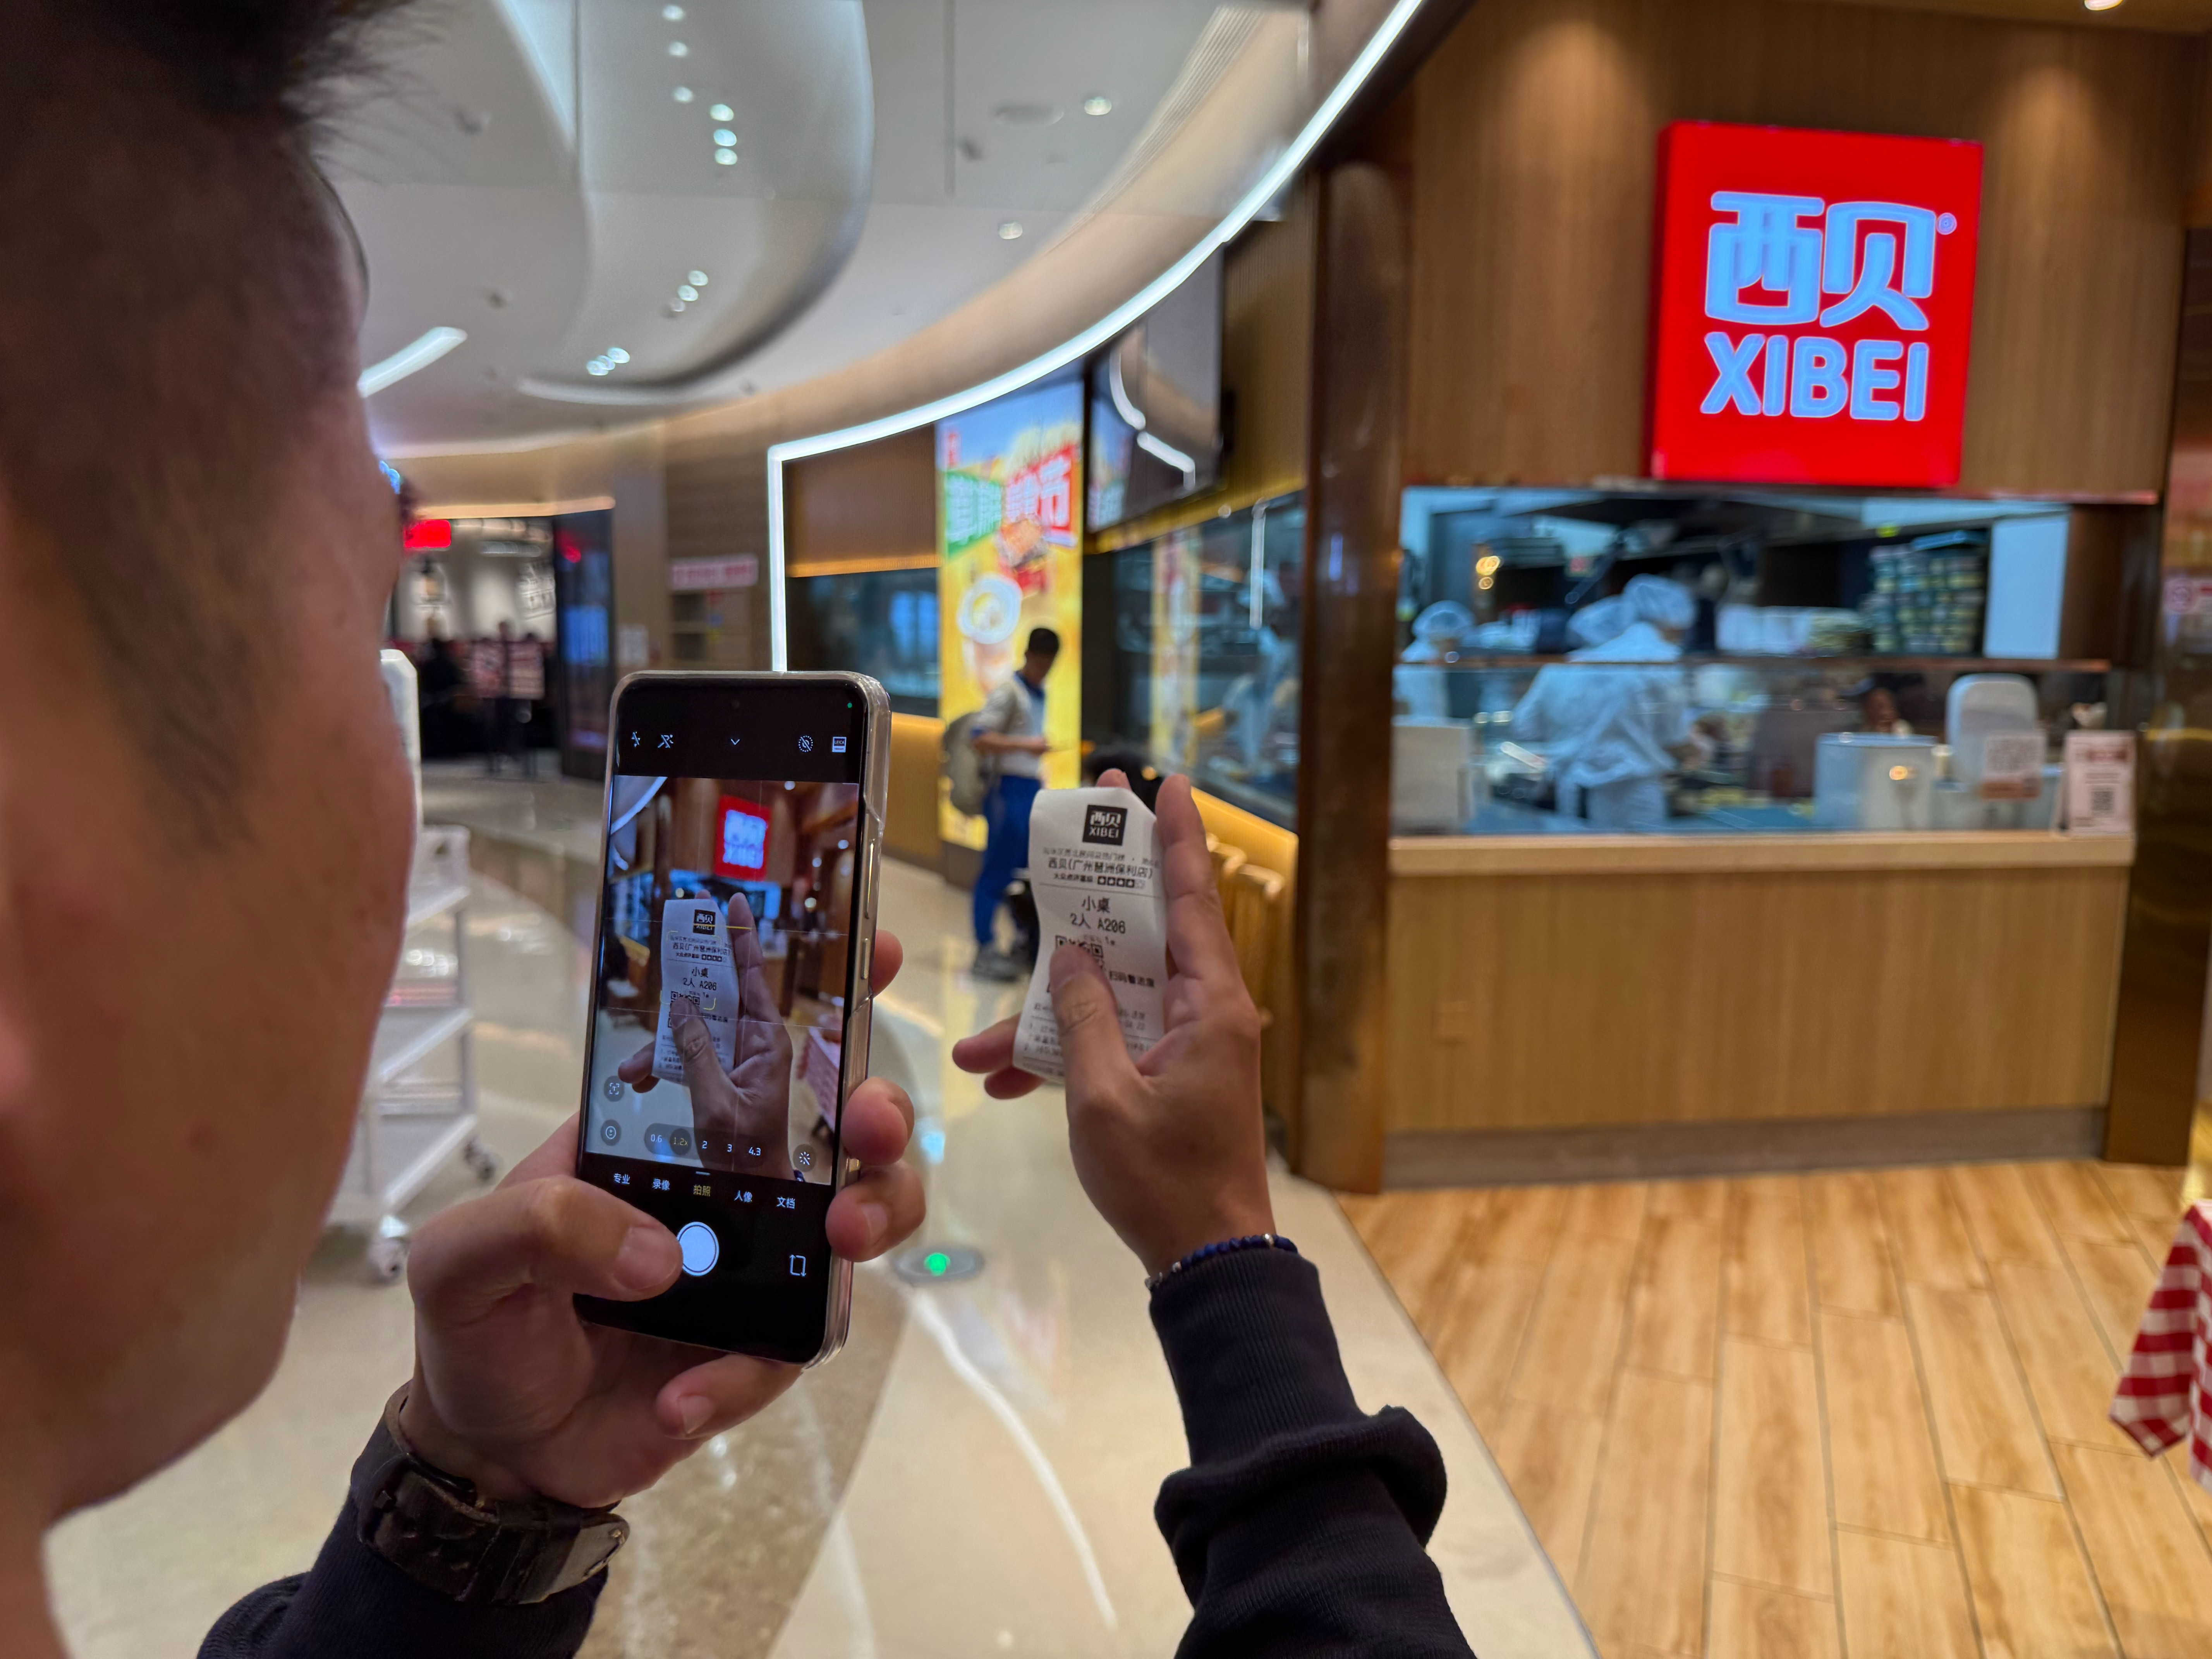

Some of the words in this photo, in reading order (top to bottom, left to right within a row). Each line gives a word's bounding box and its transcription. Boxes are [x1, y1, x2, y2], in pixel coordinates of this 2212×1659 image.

[1705, 191, 1937, 331] 西贝
[1700, 331, 1929, 422] XIBEI
[1090, 811, 1121, 828] 西贝
[1089, 826, 1119, 838] XIBEI
[1082, 895, 1110, 913] 小桌
[1070, 912, 1091, 929] 2人
[1097, 917, 1126, 934] A206
[651, 1134, 662, 1142] 0.6
[673, 1137, 688, 1146] 1.2x
[702, 1140, 708, 1149] 2
[727, 1144, 732, 1152] 3
[748, 1147, 761, 1156] 4.3
[613, 1173, 630, 1185] 专业
[652, 1177, 670, 1191] 录像
[693, 1184, 711, 1197] 拍照
[734, 1190, 753, 1202] 人像
[776, 1196, 795, 1209] 文档
